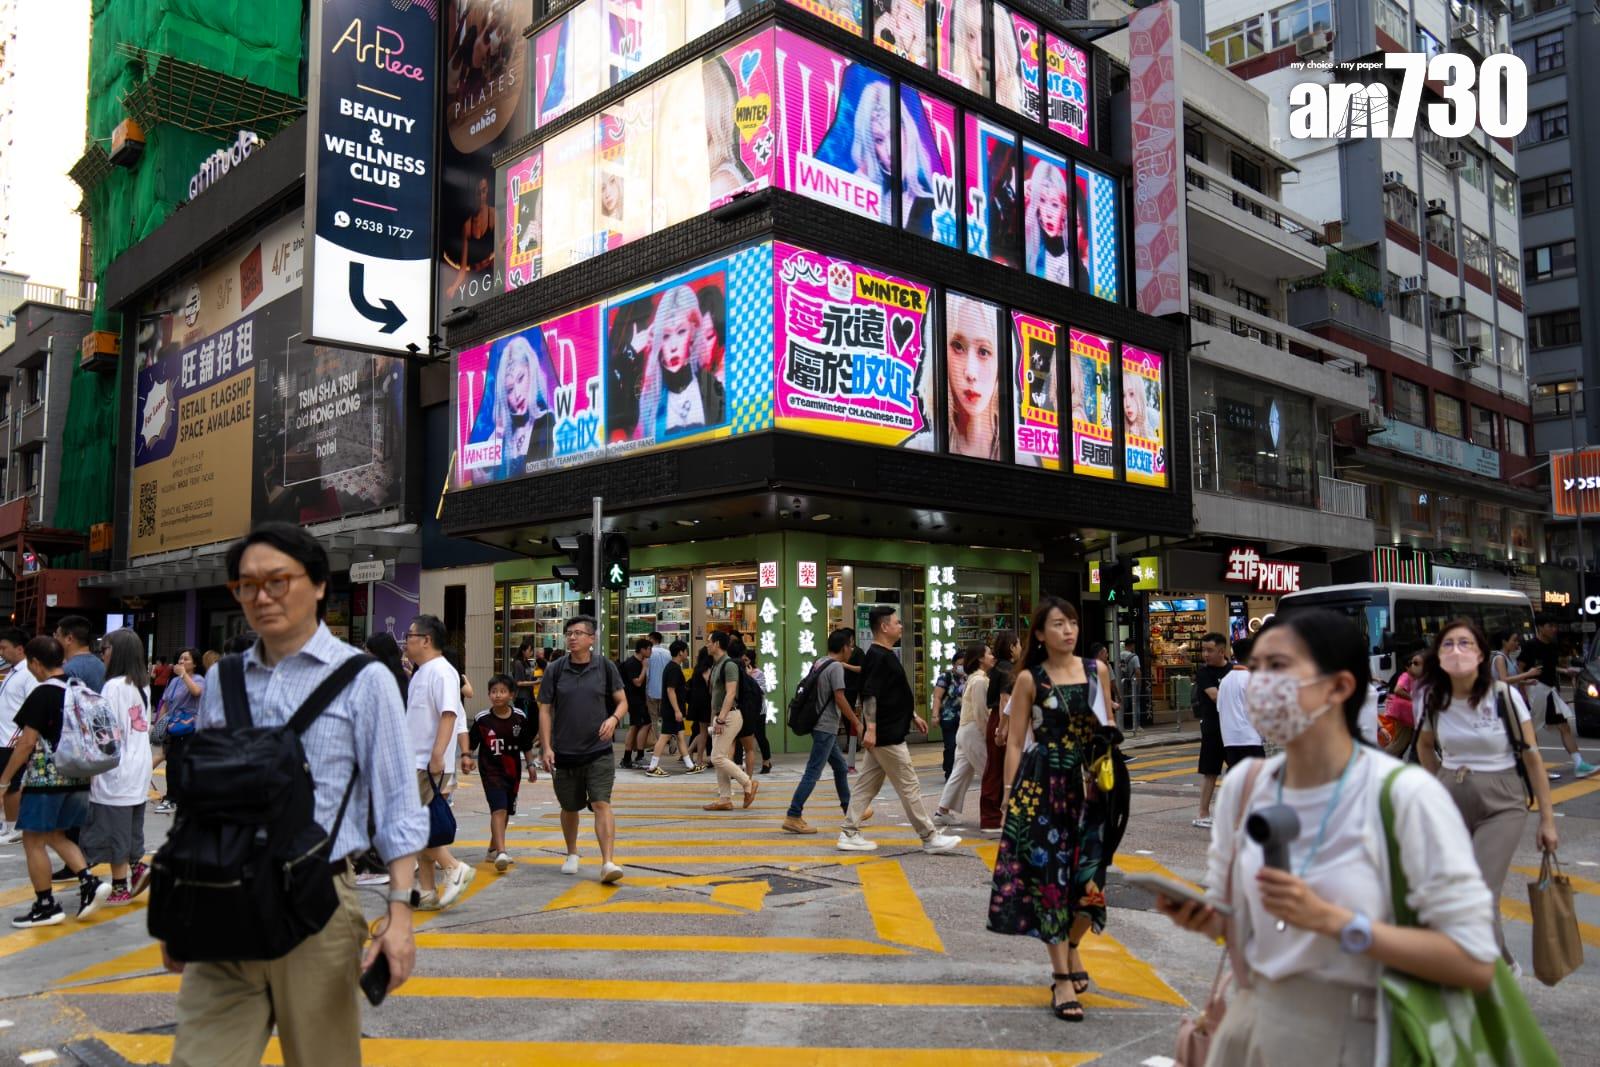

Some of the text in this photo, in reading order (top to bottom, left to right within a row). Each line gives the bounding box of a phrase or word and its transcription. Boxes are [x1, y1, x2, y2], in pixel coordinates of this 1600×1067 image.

[456, 68, 517, 119] PILATES
[340, 98, 415, 134] BEAUTY
[736, 104, 768, 121] WINTER
[369, 128, 384, 146] &
[325, 134, 426, 176] WELLNESS
[350, 162, 401, 189] CLUB
[800, 161, 880, 217] WINTER
[354, 218, 414, 240] 9538 1727
[459, 271, 503, 301] YOGA
[859, 277, 922, 310] WINTER
[789, 291, 885, 350] 愛永遠
[181, 377, 251, 421] RETAIL FLAGSHIP
[299, 370, 358, 409] TSIM SHA TSUI
[180, 401, 251, 443] SPACE AVAILABLE
[310, 403, 335, 426] HONG
[335, 393, 360, 418] KONG
[317, 438, 337, 458] hotel
[465, 444, 501, 465] WINTER
[1258, 563, 1300, 591] PHONE
